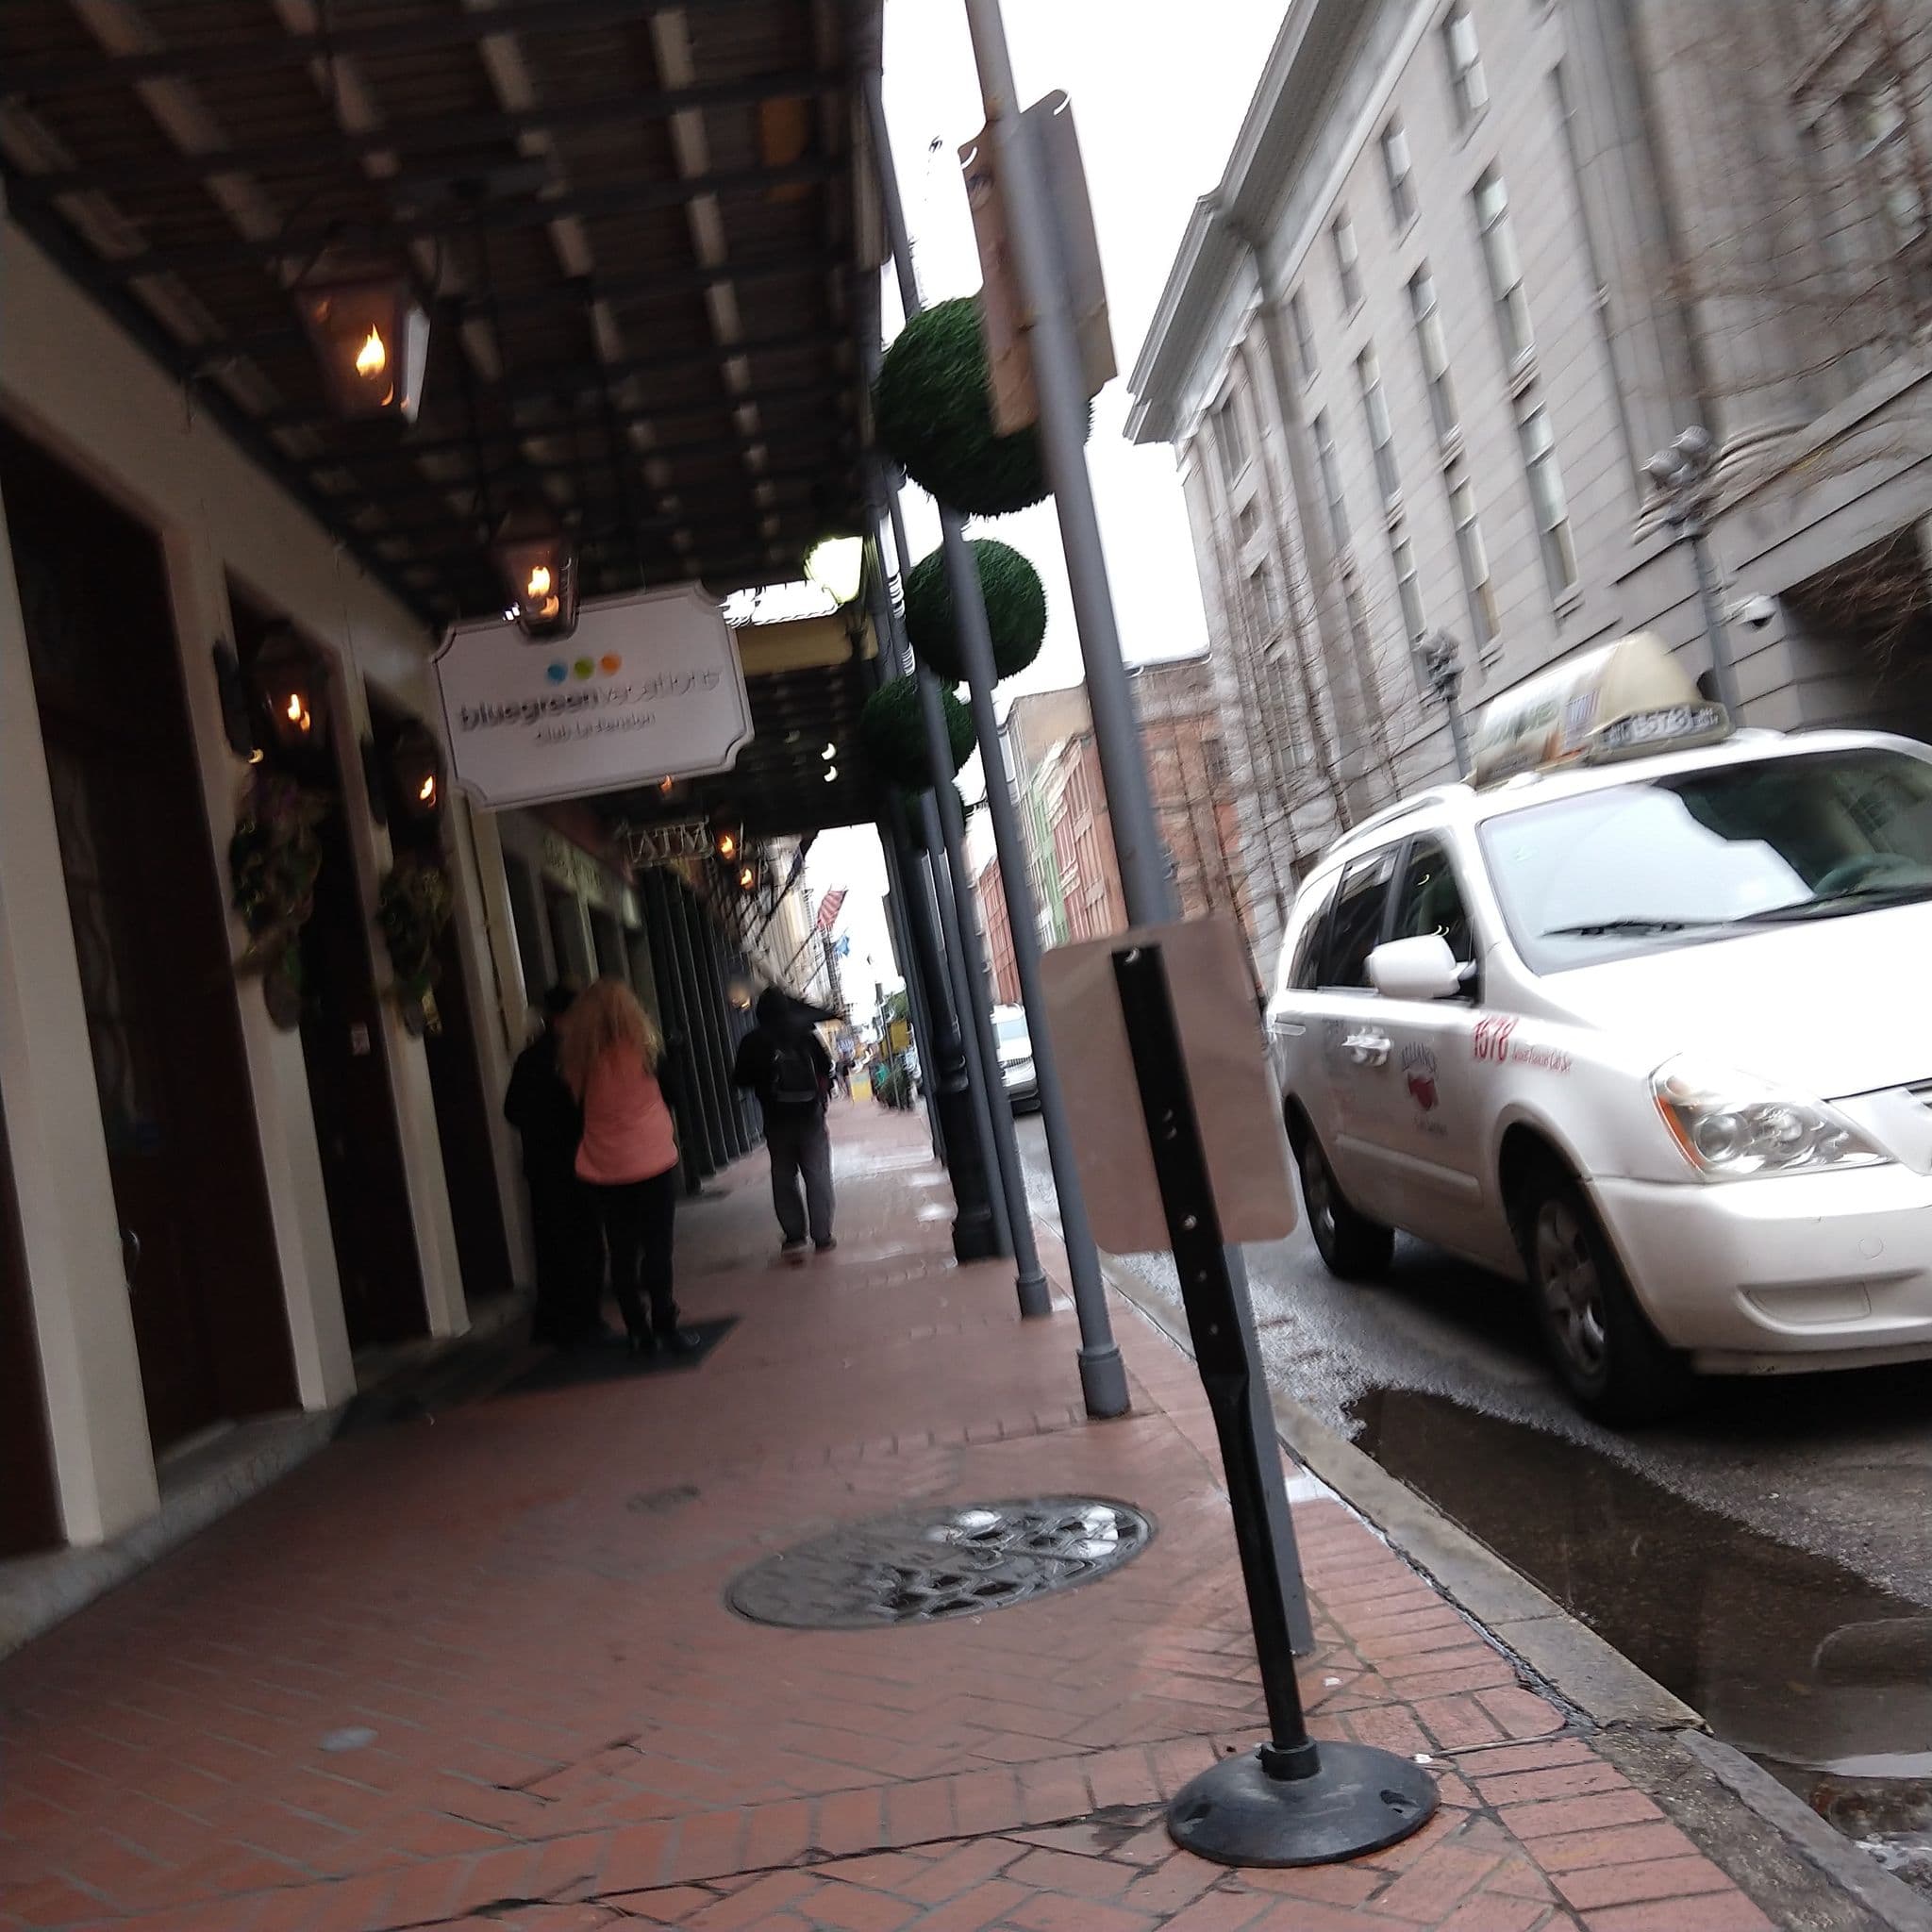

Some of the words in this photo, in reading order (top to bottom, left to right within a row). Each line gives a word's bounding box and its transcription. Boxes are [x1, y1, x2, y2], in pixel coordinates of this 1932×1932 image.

[460, 690, 599, 732] bluegreen
[601, 672, 723, 706] vacations
[633, 823, 715, 863] ATM
